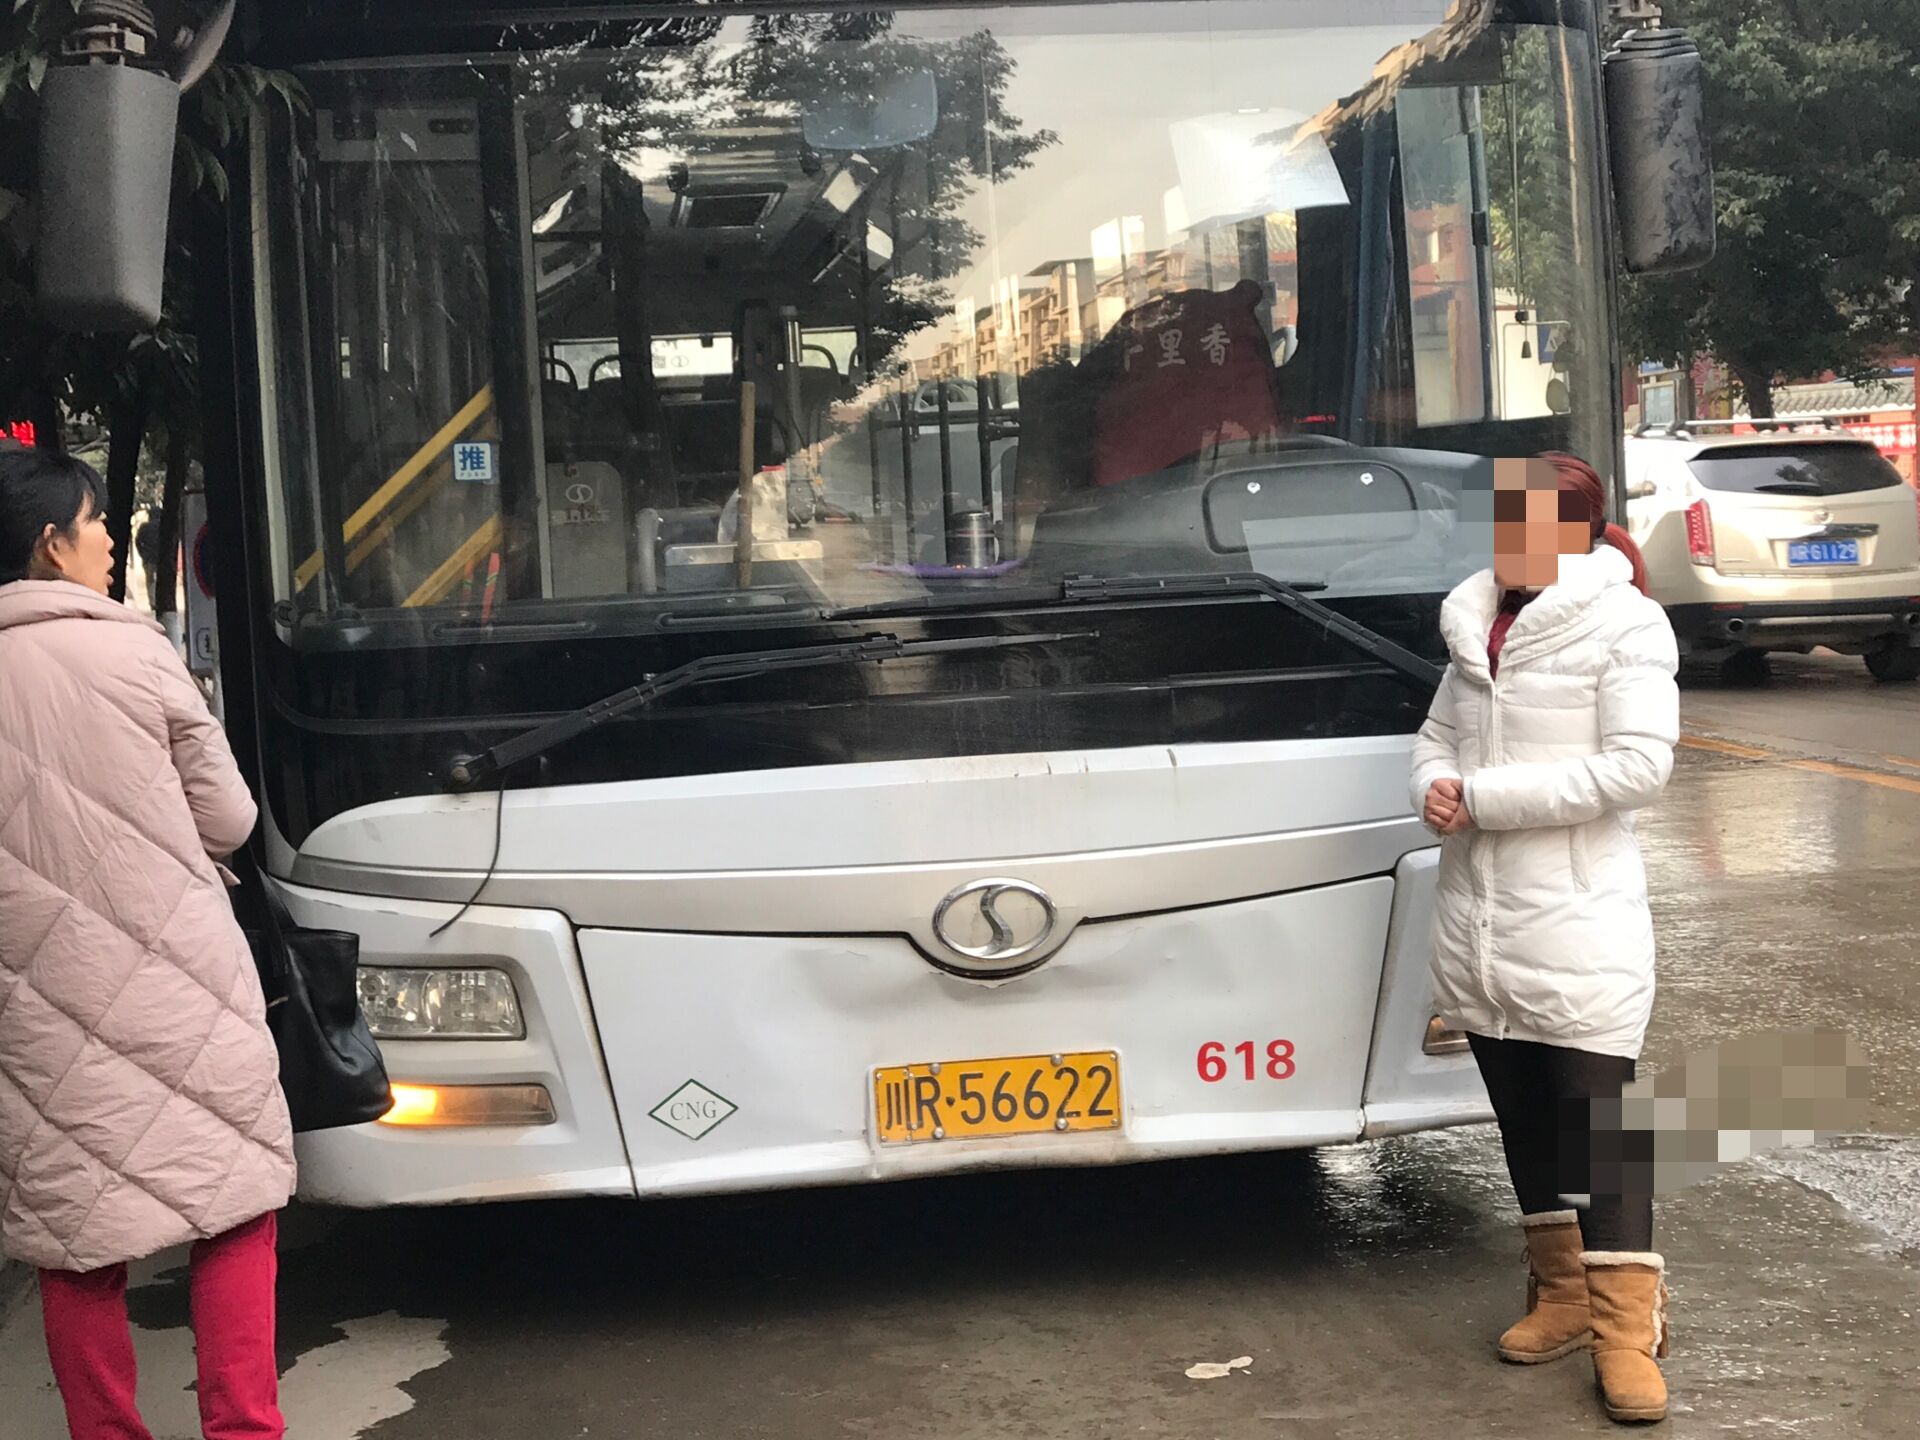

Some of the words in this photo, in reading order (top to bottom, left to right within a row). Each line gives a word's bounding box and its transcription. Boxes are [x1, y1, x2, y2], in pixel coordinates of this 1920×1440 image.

[459, 445, 486, 471] 推
[1197, 1039, 1296, 1082] 618
[670, 1100, 717, 1121] CNG
